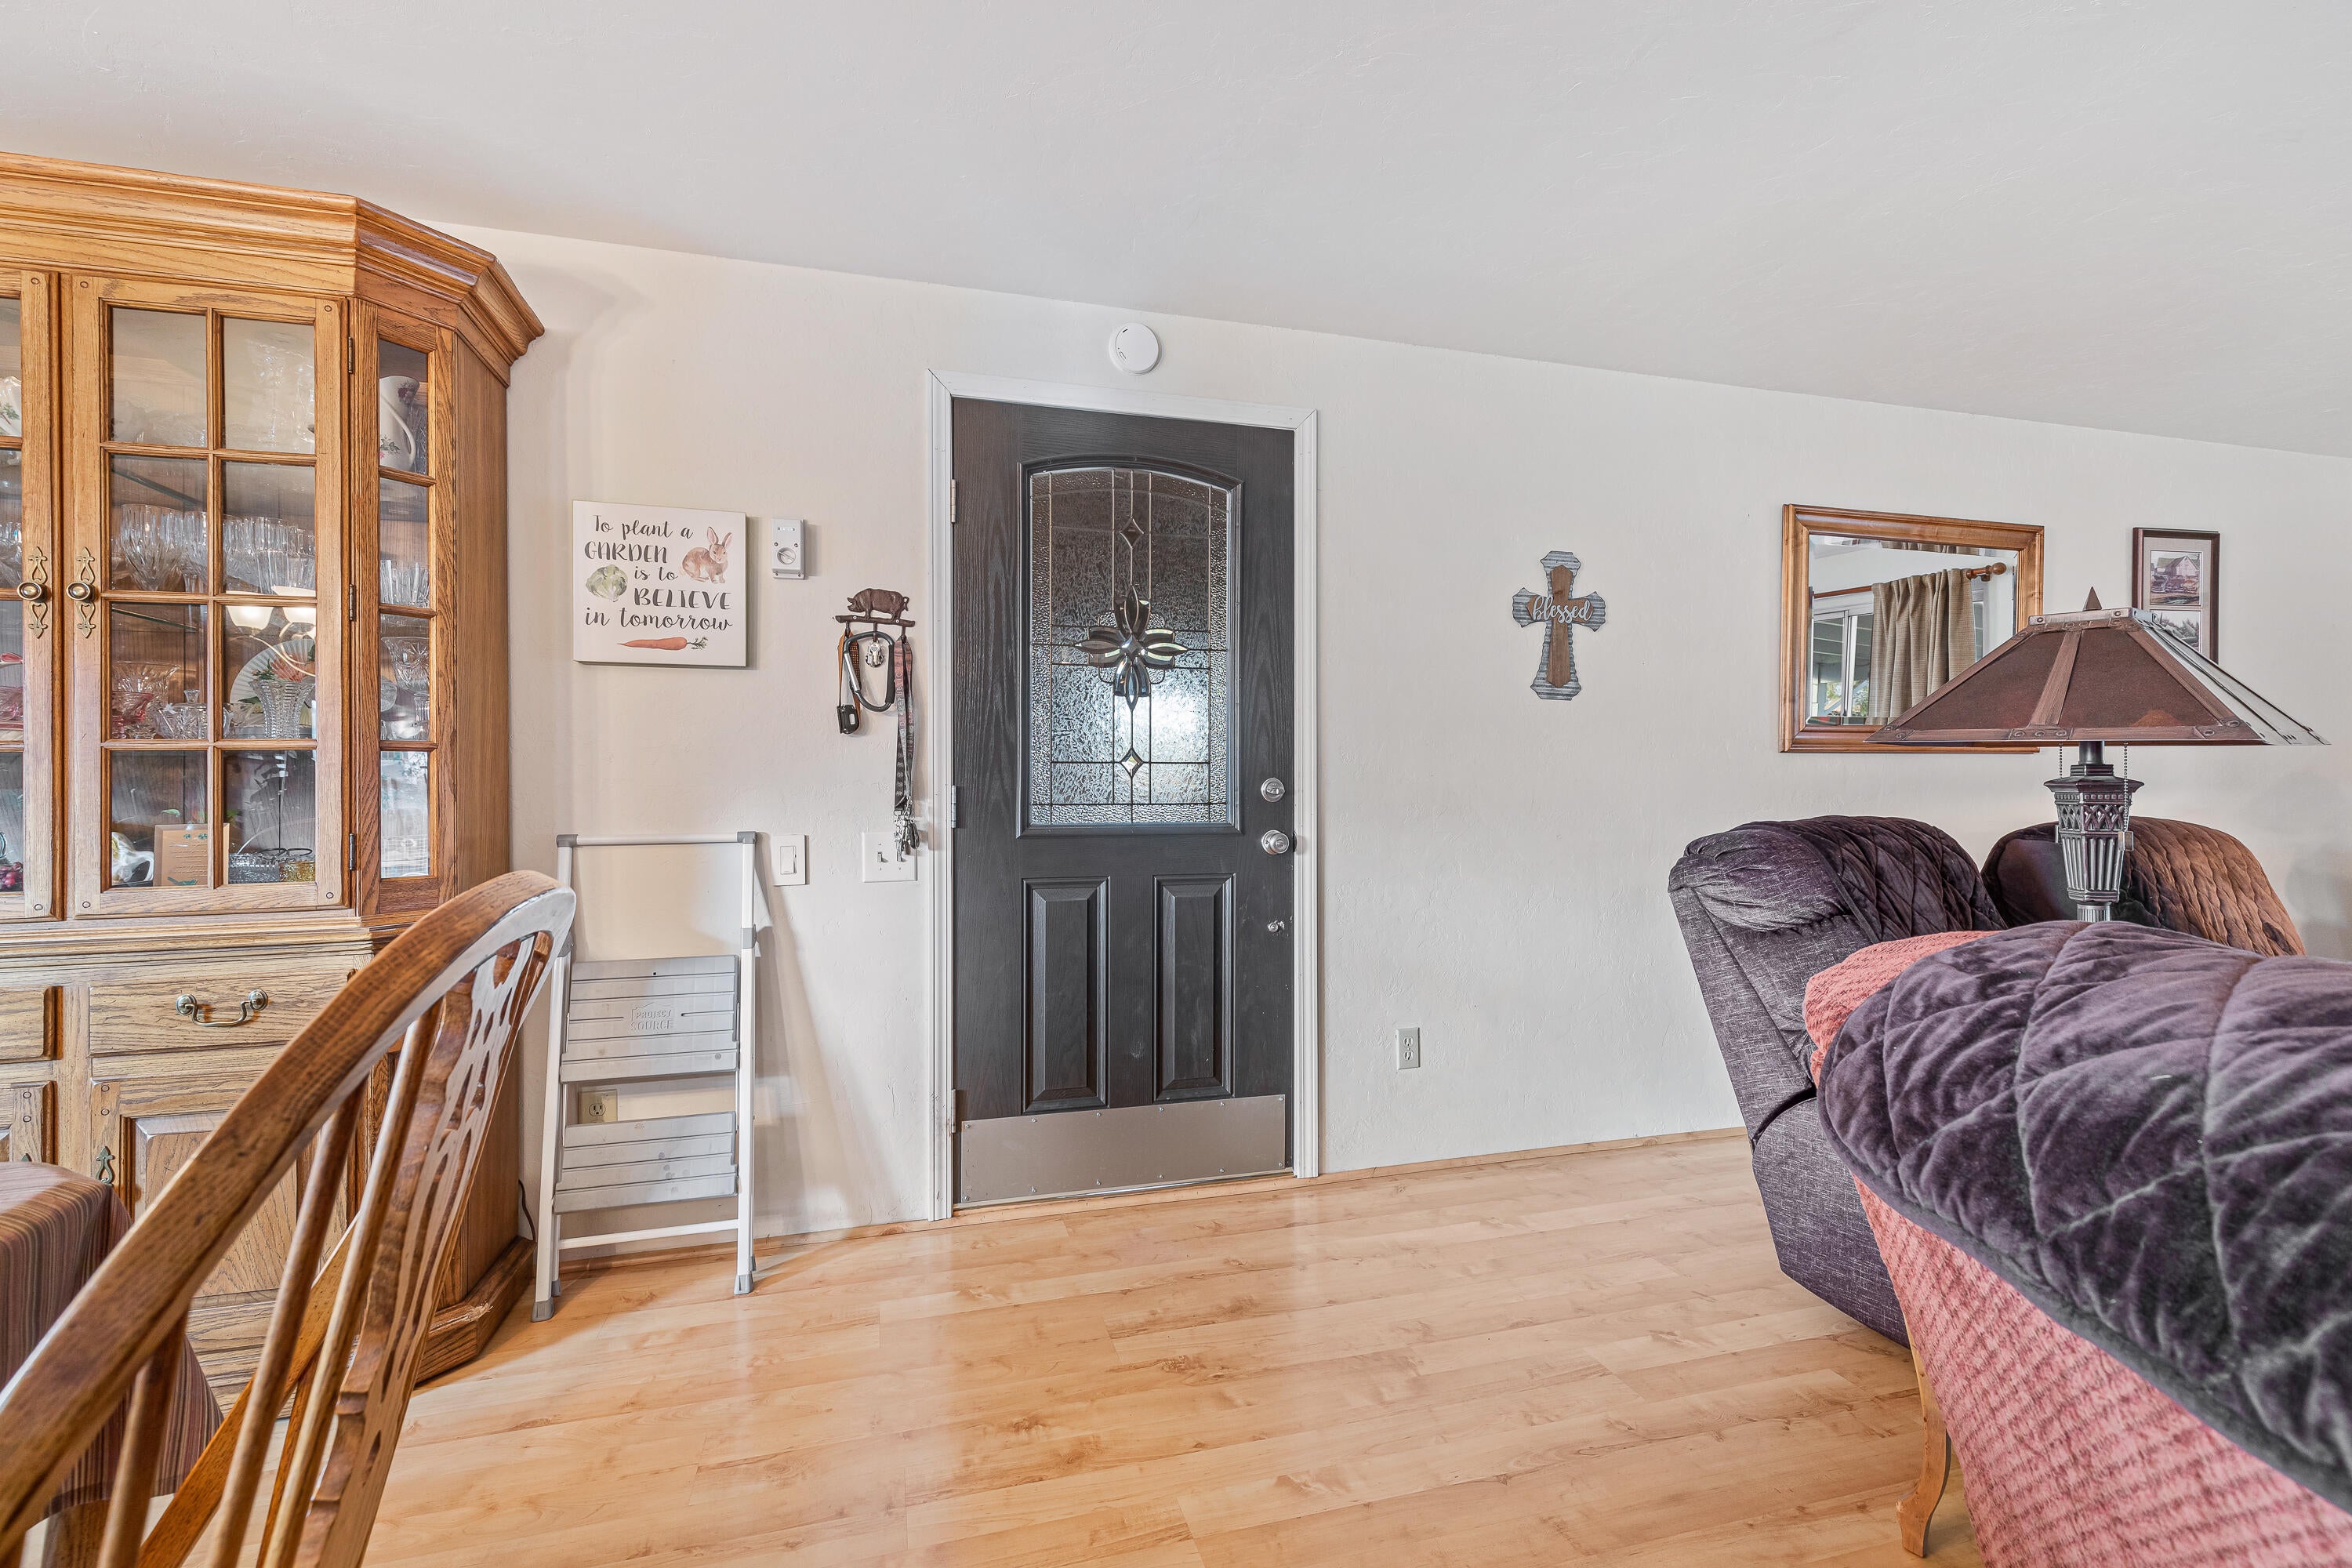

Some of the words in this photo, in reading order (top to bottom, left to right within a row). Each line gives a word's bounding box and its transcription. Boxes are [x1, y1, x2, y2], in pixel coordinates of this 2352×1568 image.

[593, 515, 613, 533] To
[622, 520, 673, 540] plant
[681, 528, 693, 539] a
[584, 541, 667, 563] GARDEN
[633, 566, 650, 580] is
[658, 567, 678, 581] to
[633, 588, 731, 610] BELIEVE
[1532, 595, 1593, 624] blessed
[585, 607, 610, 626] in
[619, 608, 733, 630] tomorrow
[630, 1019, 673, 1031] SOURCE
[636, 1010, 672, 1019] PROJECT
